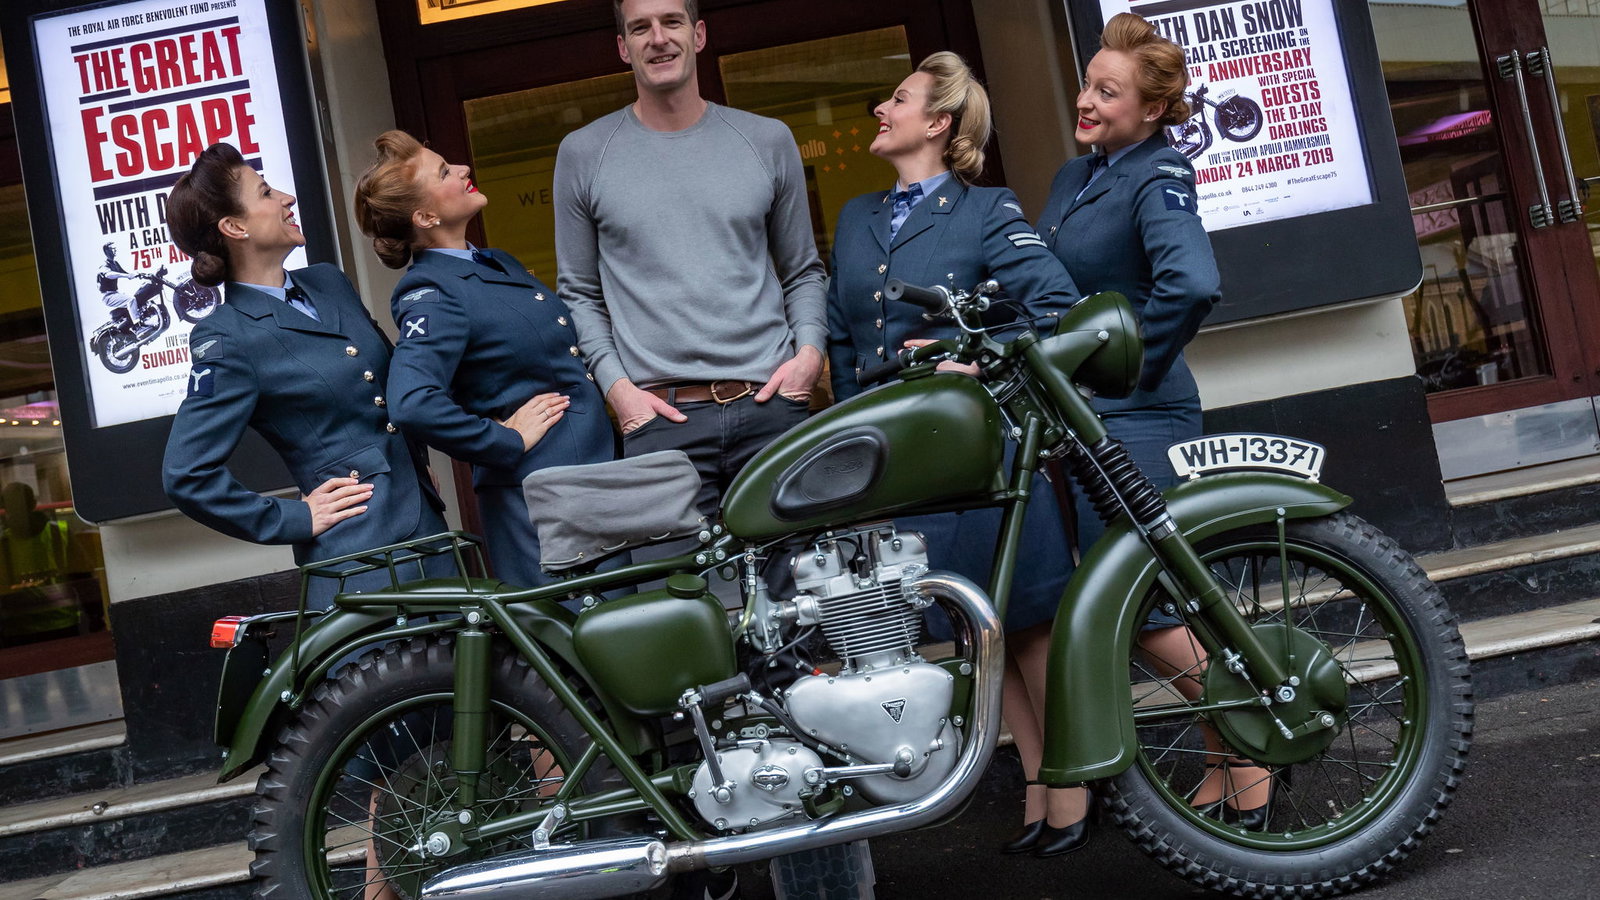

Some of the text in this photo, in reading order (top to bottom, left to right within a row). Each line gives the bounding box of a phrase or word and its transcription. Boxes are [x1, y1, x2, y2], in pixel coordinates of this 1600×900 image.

[68, 0, 237, 38] THE ROYAL AIR FORCE BENEVOLENT FUND PRESENTS
[1149, 0, 1303, 46] ITH DAN SNOW
[1220, 30, 1297, 60] SCREENING
[1299, 28, 1309, 37] ON
[1299, 37, 1310, 46] THE
[74, 26, 243, 94] THE GREAT
[1208, 47, 1312, 83] ANNIVERSARY
[1258, 68, 1316, 87] WITH SPECIAL
[1261, 80, 1321, 108] GUESTS
[1265, 101, 1323, 124] THE D-DAY
[80, 92, 260, 183] ESCAPE
[1268, 117, 1328, 141] DARLINGS
[800, 140, 827, 160] ollo
[1208, 152, 1221, 166] LIVE
[1232, 146, 1258, 162] EVENTIM
[1260, 141, 1283, 156] APOLLO
[1284, 133, 1331, 153] HAMMERSMITH
[1195, 147, 1334, 186] UNDAY 24 MARCH 2019
[95, 196, 150, 235] WITH
[130, 226, 173, 250] A GAL
[131, 246, 162, 270] 75TH
[165, 335, 178, 348] LIVE
[142, 346, 189, 370] SUNDAY
[122, 373, 188, 390] www.eventimapollo.co.uk
[1180, 438, 1319, 472] WH-13371
